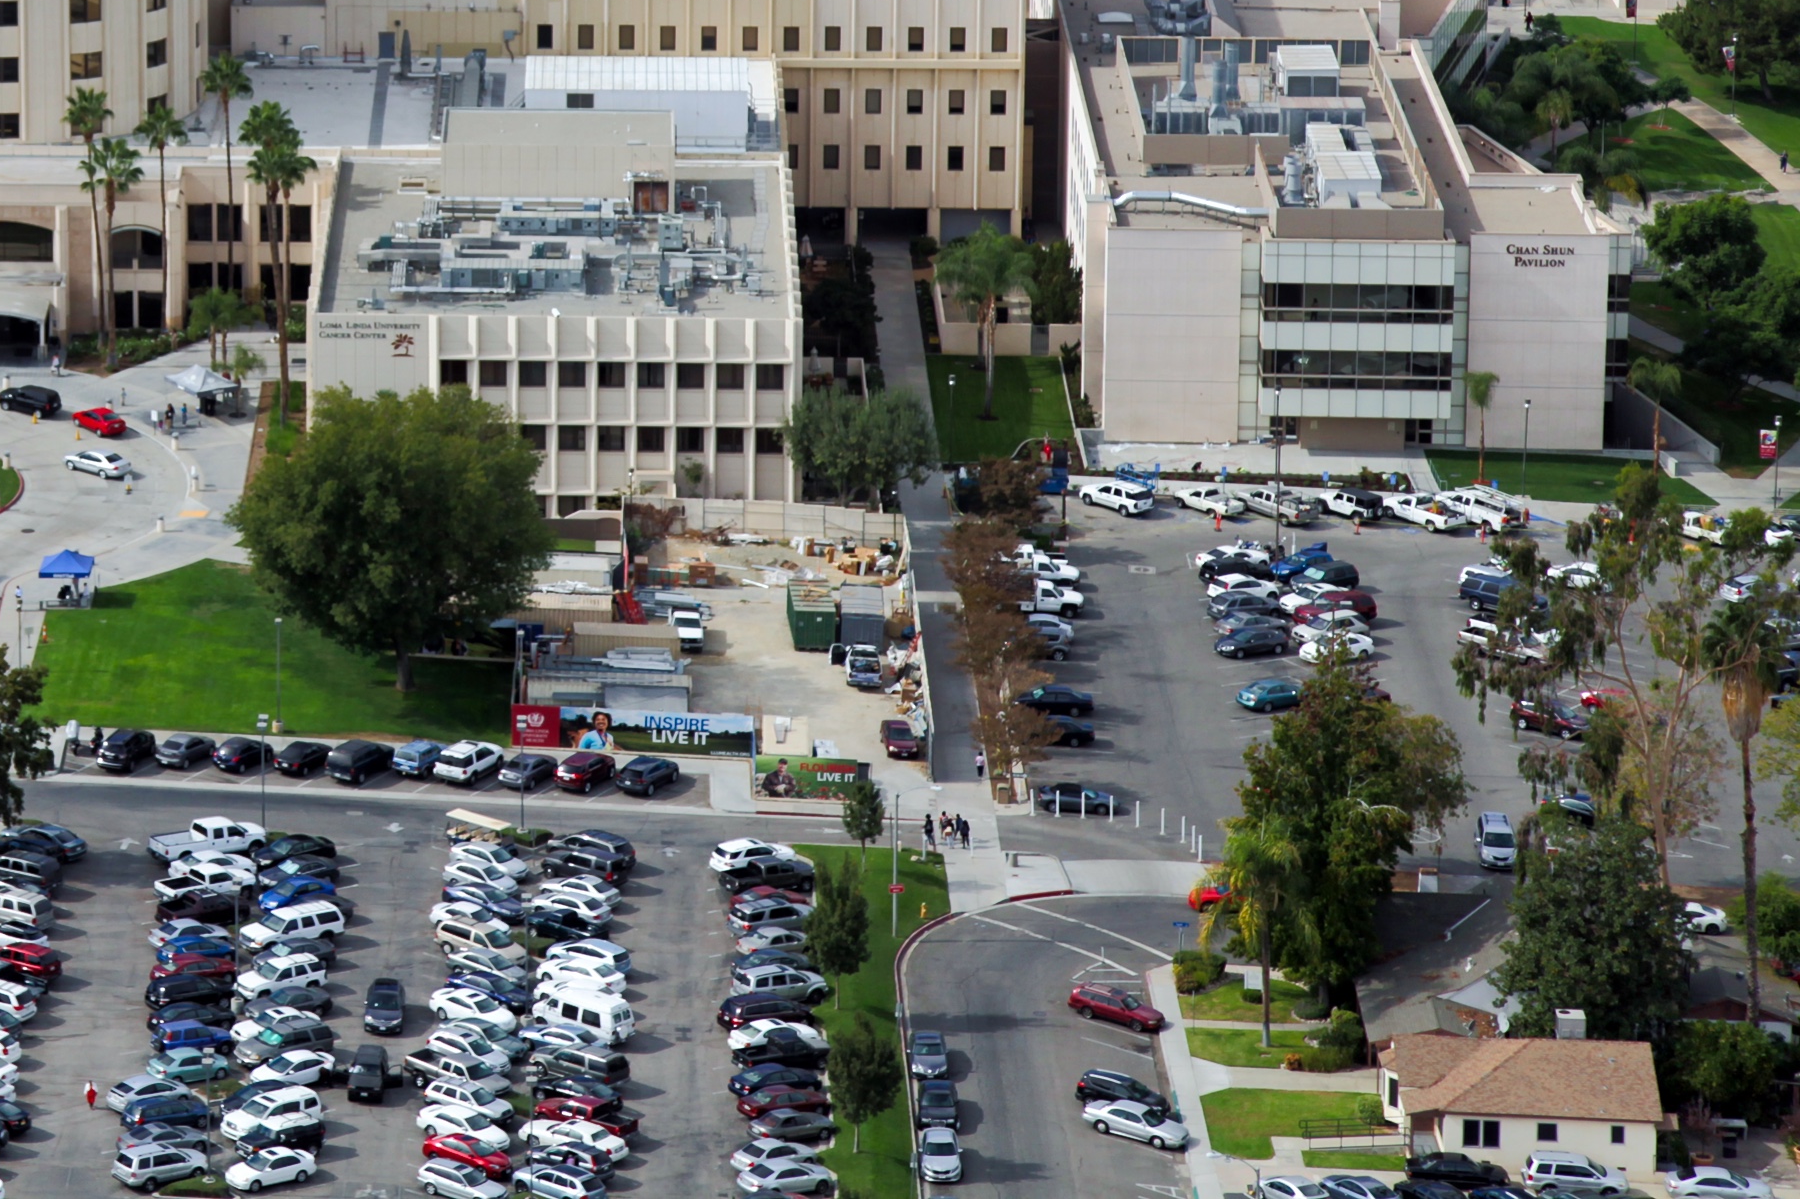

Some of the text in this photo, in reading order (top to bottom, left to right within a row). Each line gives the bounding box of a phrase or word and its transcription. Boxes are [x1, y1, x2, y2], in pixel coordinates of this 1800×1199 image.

[1506, 244, 1575, 256] CHAN SHUN
[1514, 257, 1566, 267] PAVILION
[319, 321, 421, 330] LOMA LINDA UNIVERSITY
[353, 331, 387, 339] CENTER
[644, 715, 710, 732] INSPIRE
[652, 729, 710, 745] LIVE IT
[816, 772, 855, 782] LIVE IT
